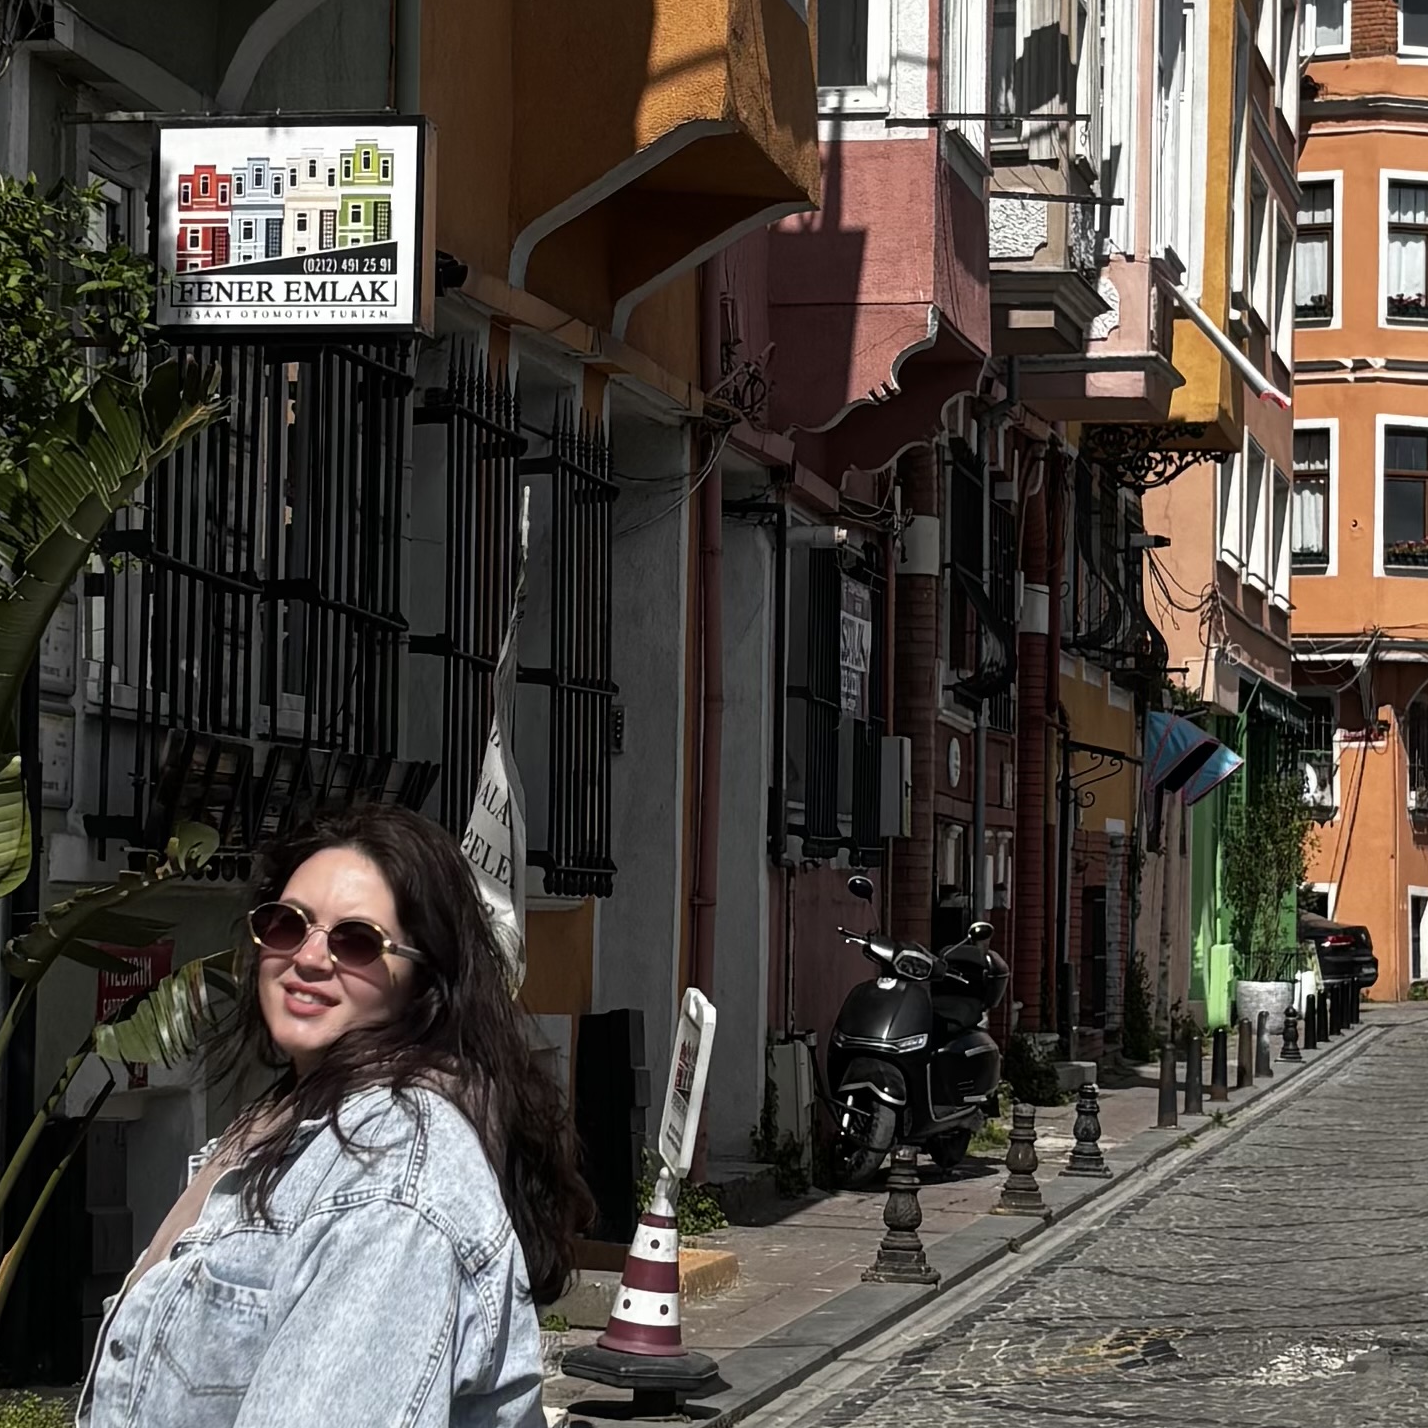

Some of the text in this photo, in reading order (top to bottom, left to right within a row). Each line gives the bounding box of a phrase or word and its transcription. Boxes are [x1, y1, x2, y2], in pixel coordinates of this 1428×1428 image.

[303, 257, 391, 274] (0212) 491 25 91
[178, 280, 390, 303] FENER EMLAK
